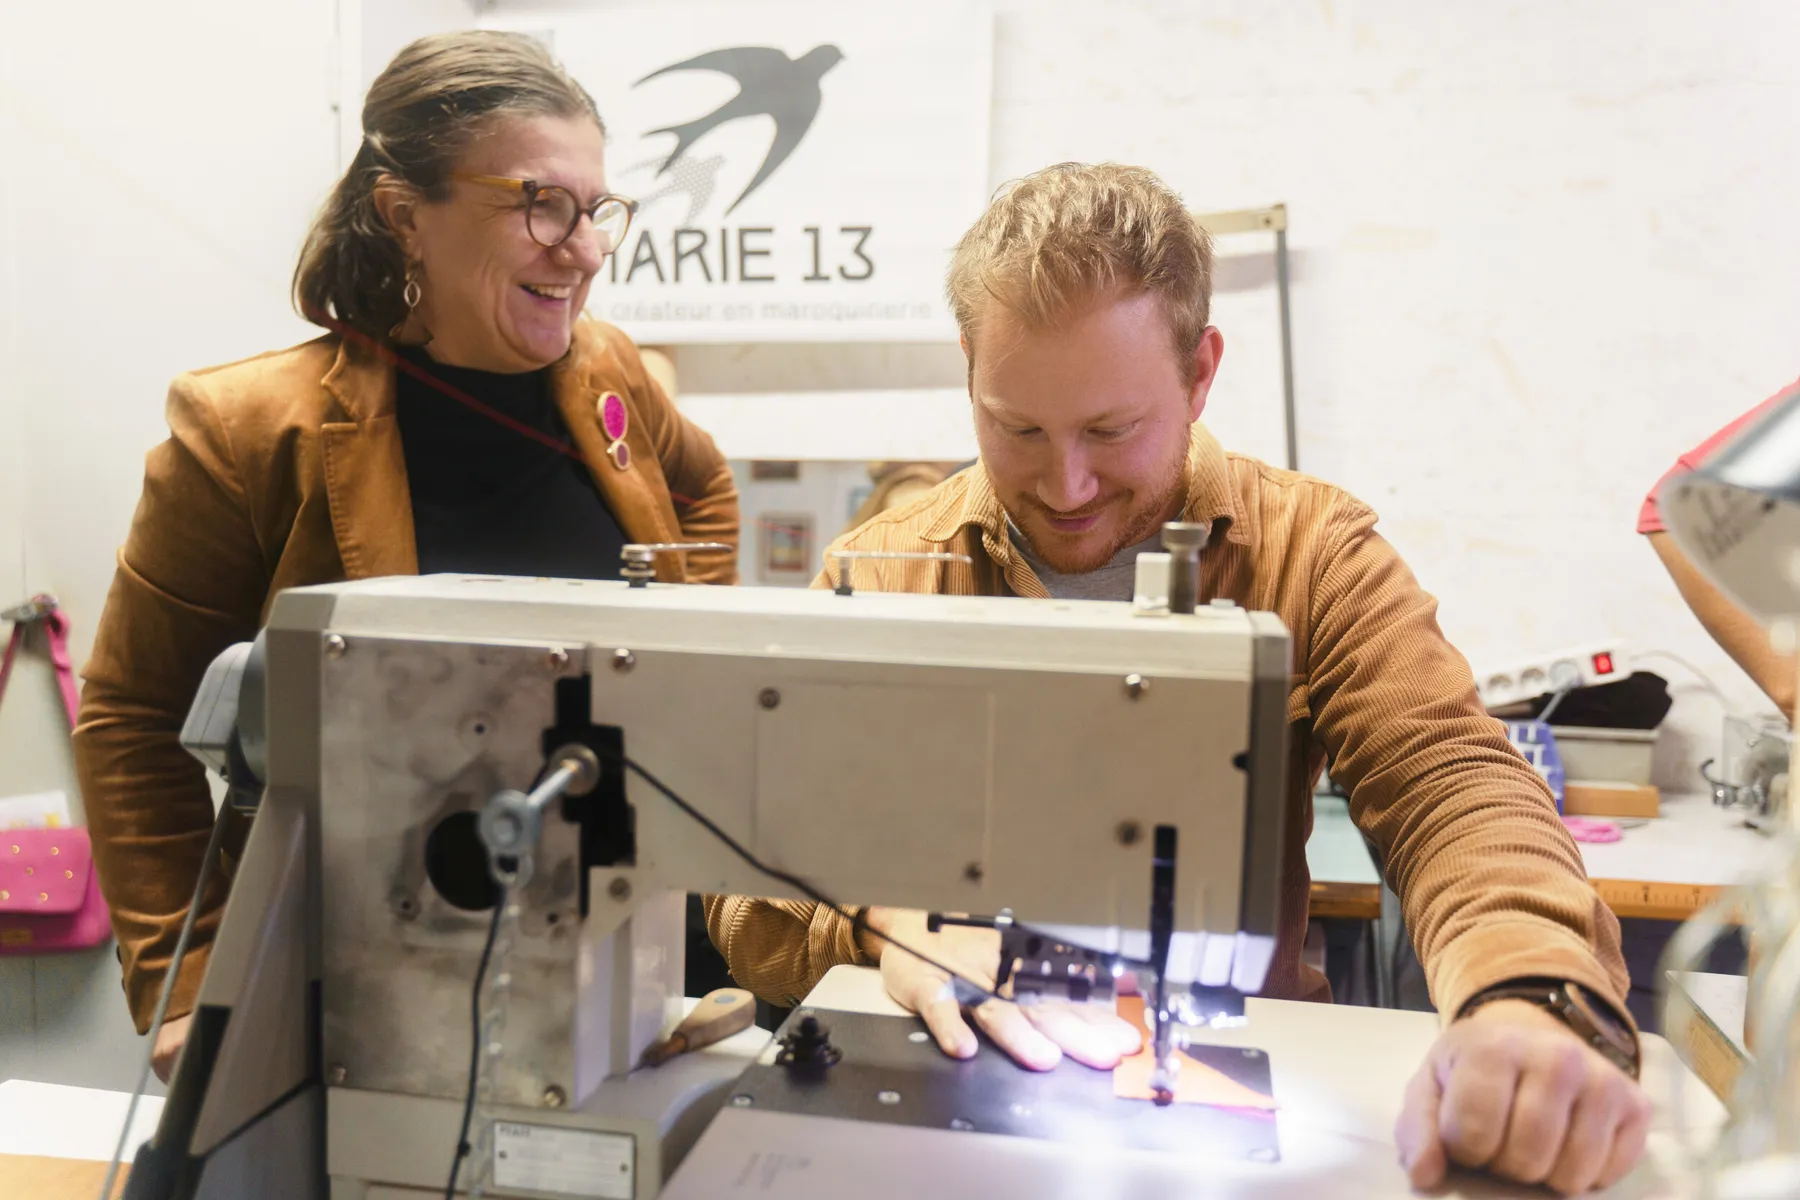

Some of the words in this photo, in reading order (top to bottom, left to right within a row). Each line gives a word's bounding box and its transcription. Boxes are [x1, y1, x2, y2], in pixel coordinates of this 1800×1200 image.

[610, 226, 776, 284] ARIE
[801, 225, 875, 282] 13
[609, 298, 712, 322] créateur
[721, 302, 754, 322] en
